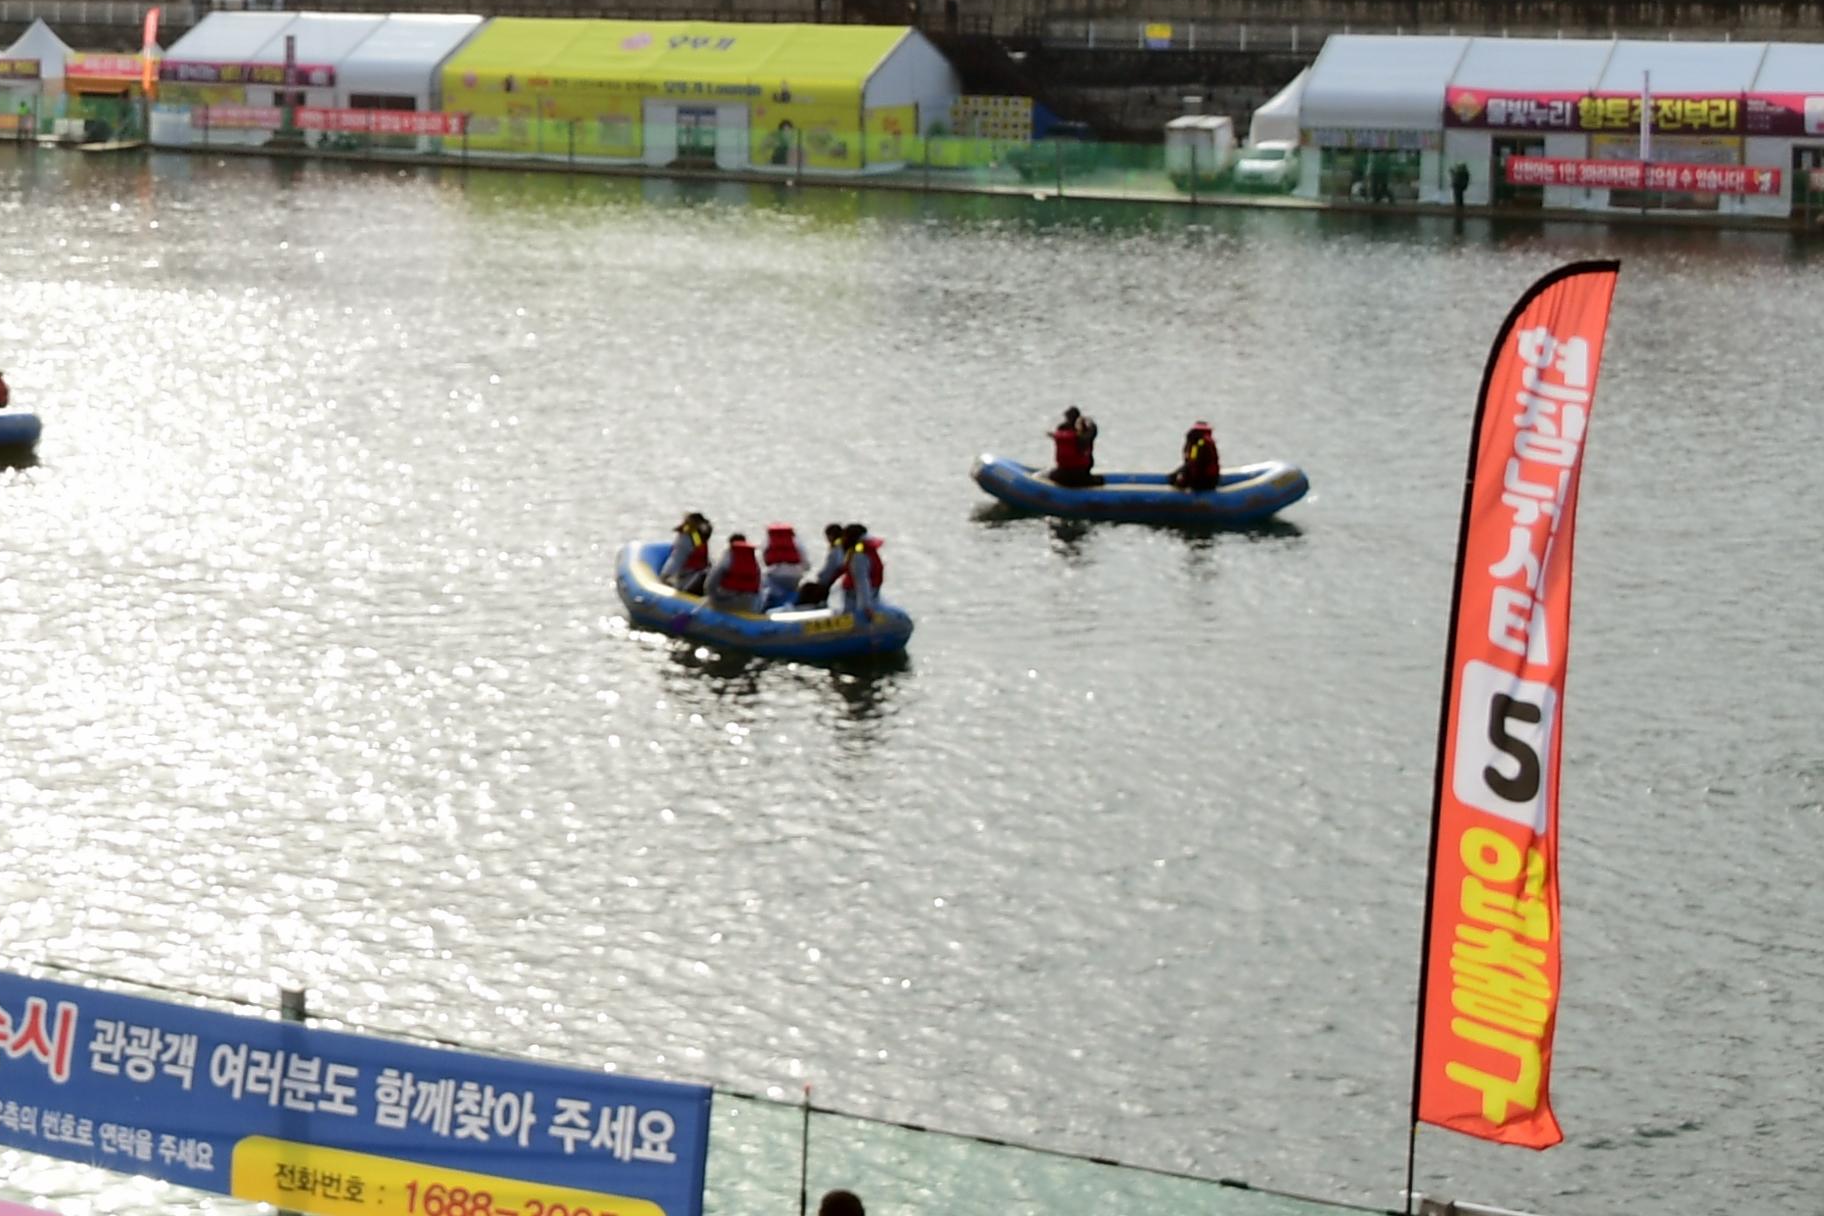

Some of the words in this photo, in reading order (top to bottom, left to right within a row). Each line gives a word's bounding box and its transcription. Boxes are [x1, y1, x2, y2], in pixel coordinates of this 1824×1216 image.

[1482, 692, 1542, 803] 5
[89, 1018, 198, 1090] 관광객
[209, 1041, 359, 1116] 여러분도
[375, 1067, 536, 1146] 함께찾아
[547, 1096, 677, 1164] 주세요
[41, 1109, 94, 1147] 번호로
[99, 1121, 153, 1161] 연락을
[158, 1132, 215, 1172] 주세요
[273, 1162, 366, 1204] 전화번호
